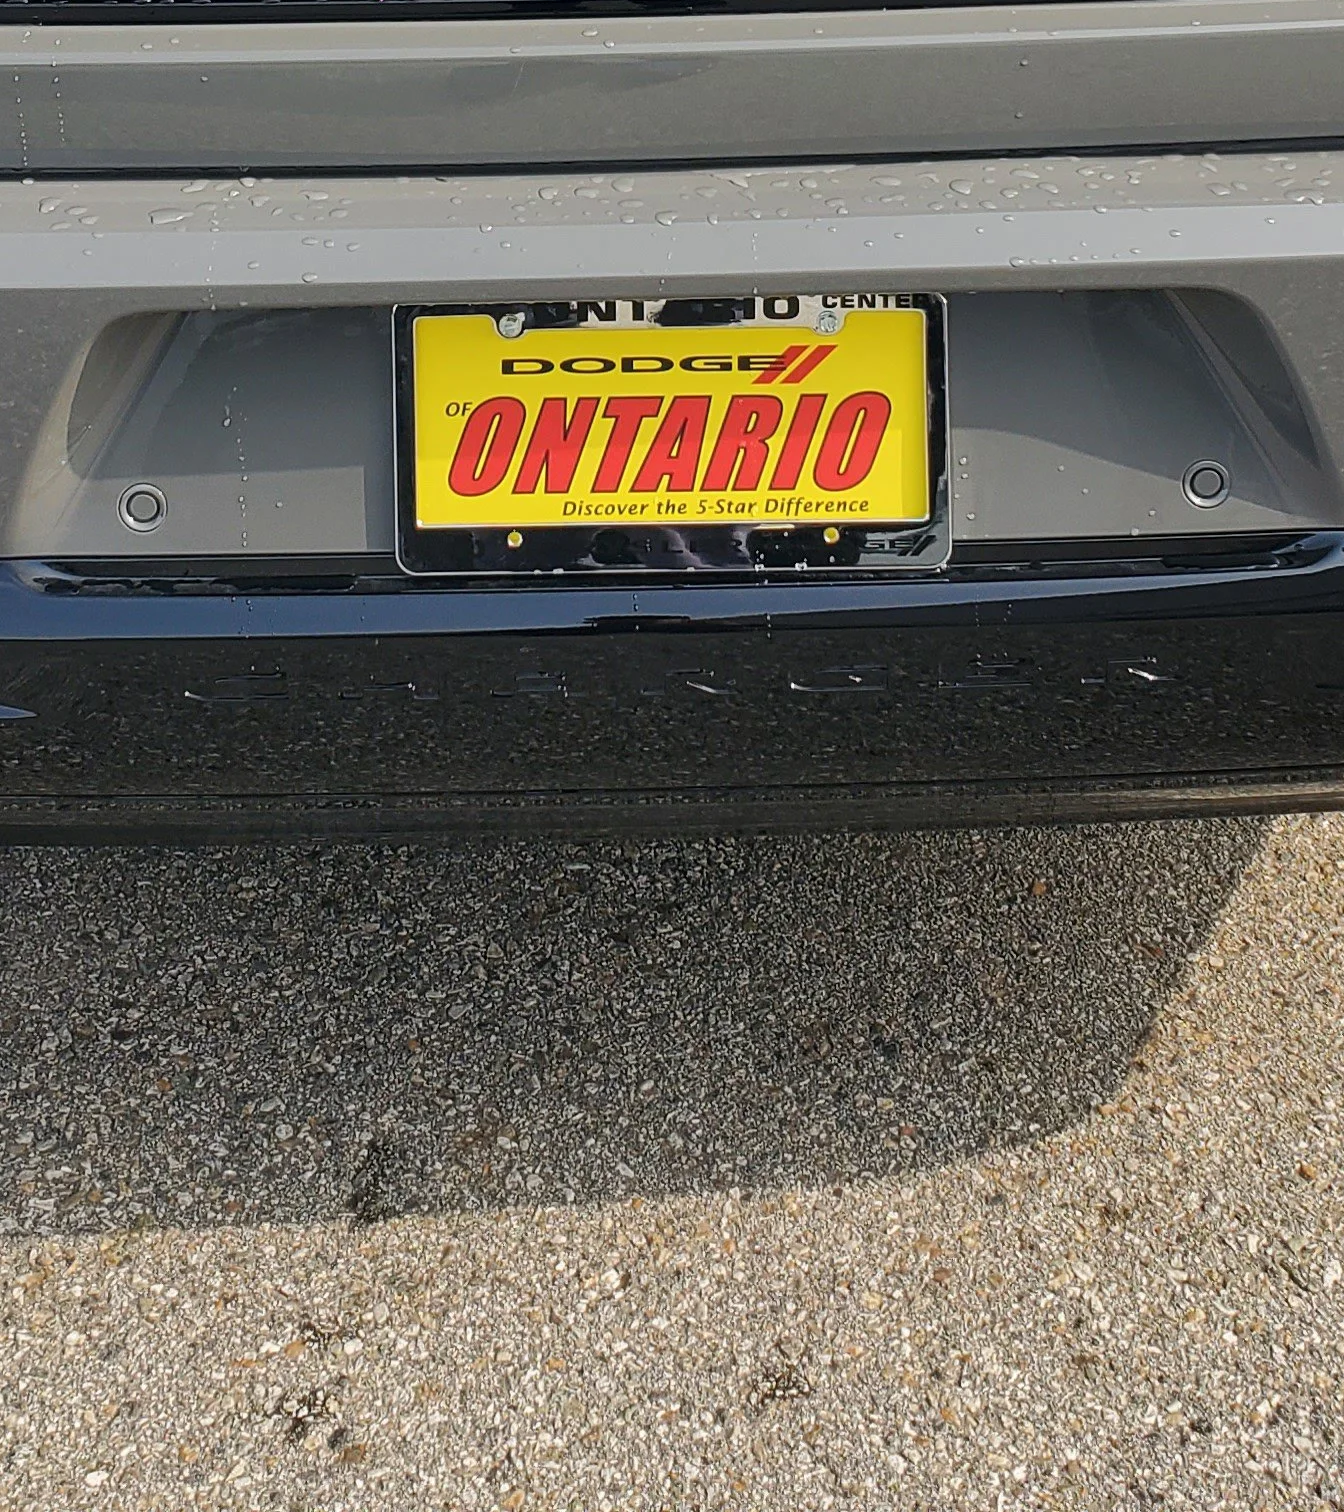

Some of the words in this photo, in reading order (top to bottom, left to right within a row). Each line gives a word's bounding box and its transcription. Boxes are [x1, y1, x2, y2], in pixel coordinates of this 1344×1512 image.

[821, 293, 928, 310] CENTE
[500, 354, 787, 376] DODGE
[445, 401, 473, 418] OF
[447, 390, 892, 497] ONTARIO
[562, 499, 649, 517] Discover
[656, 498, 688, 516] the
[696, 498, 757, 515] 5-Star
[764, 497, 869, 517] Difference
